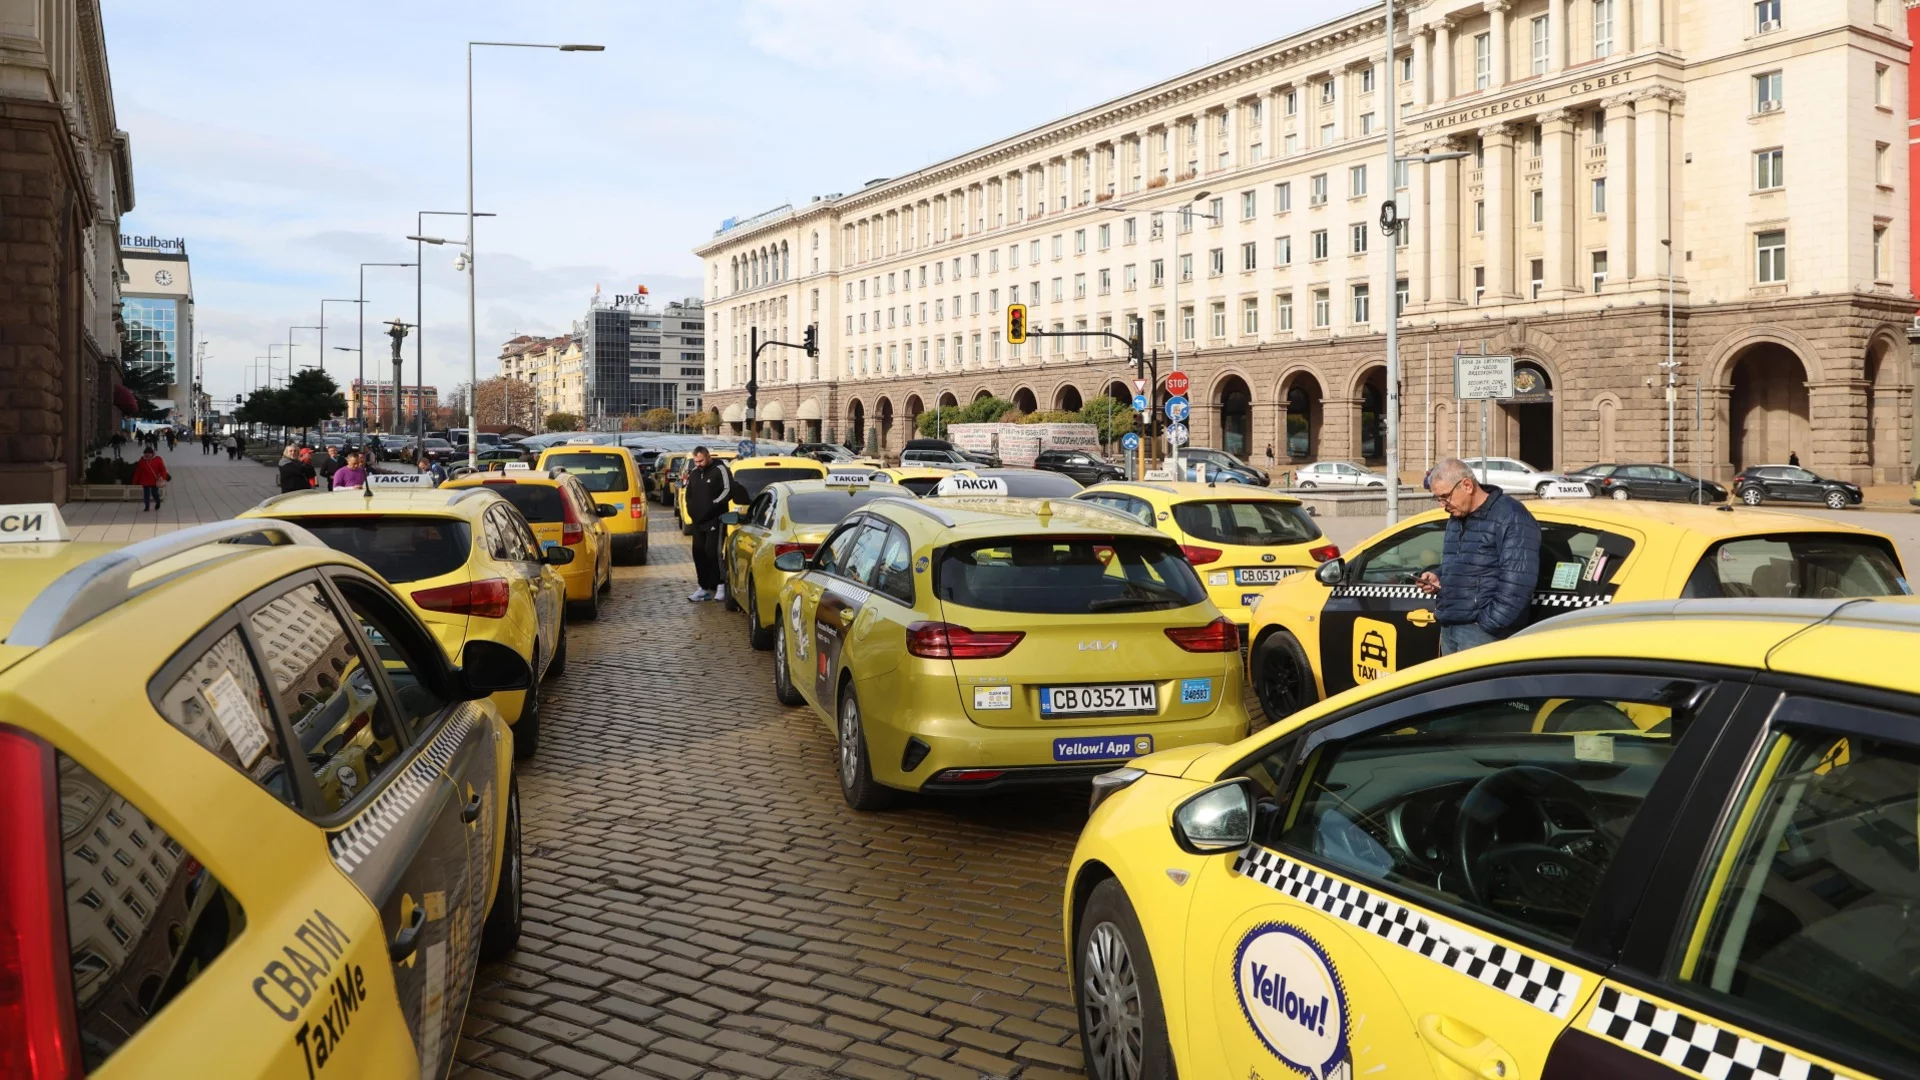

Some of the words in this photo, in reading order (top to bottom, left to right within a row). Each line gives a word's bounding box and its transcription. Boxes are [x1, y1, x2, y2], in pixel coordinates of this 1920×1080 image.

[1424, 93, 1545, 131] МИНИСТЕРСКИ
[1570, 71, 1632, 95] СЪВЕТ
[134, 235, 184, 249] Bulbank
[615, 294, 645, 306] pwc
[1168, 379, 1188, 388] STOP
[374, 475, 420, 483] ТАКСИ
[954, 479, 998, 490] ТАКСИ
[0, 513, 42, 533] СИ
[1241, 570, 1255, 581] CB
[1256, 569, 1280, 581] 0512
[1053, 690, 1078, 709] CB
[1081, 688, 1126, 708] 0352
[1129, 687, 1153, 706] TM
[1058, 743, 1103, 756] Yellow!
[1106, 742, 1131, 755] App
[252, 908, 351, 1022] СВАЛИ
[1251, 961, 1329, 1038] Yellow!
[295, 963, 366, 1080] TaxiMe
